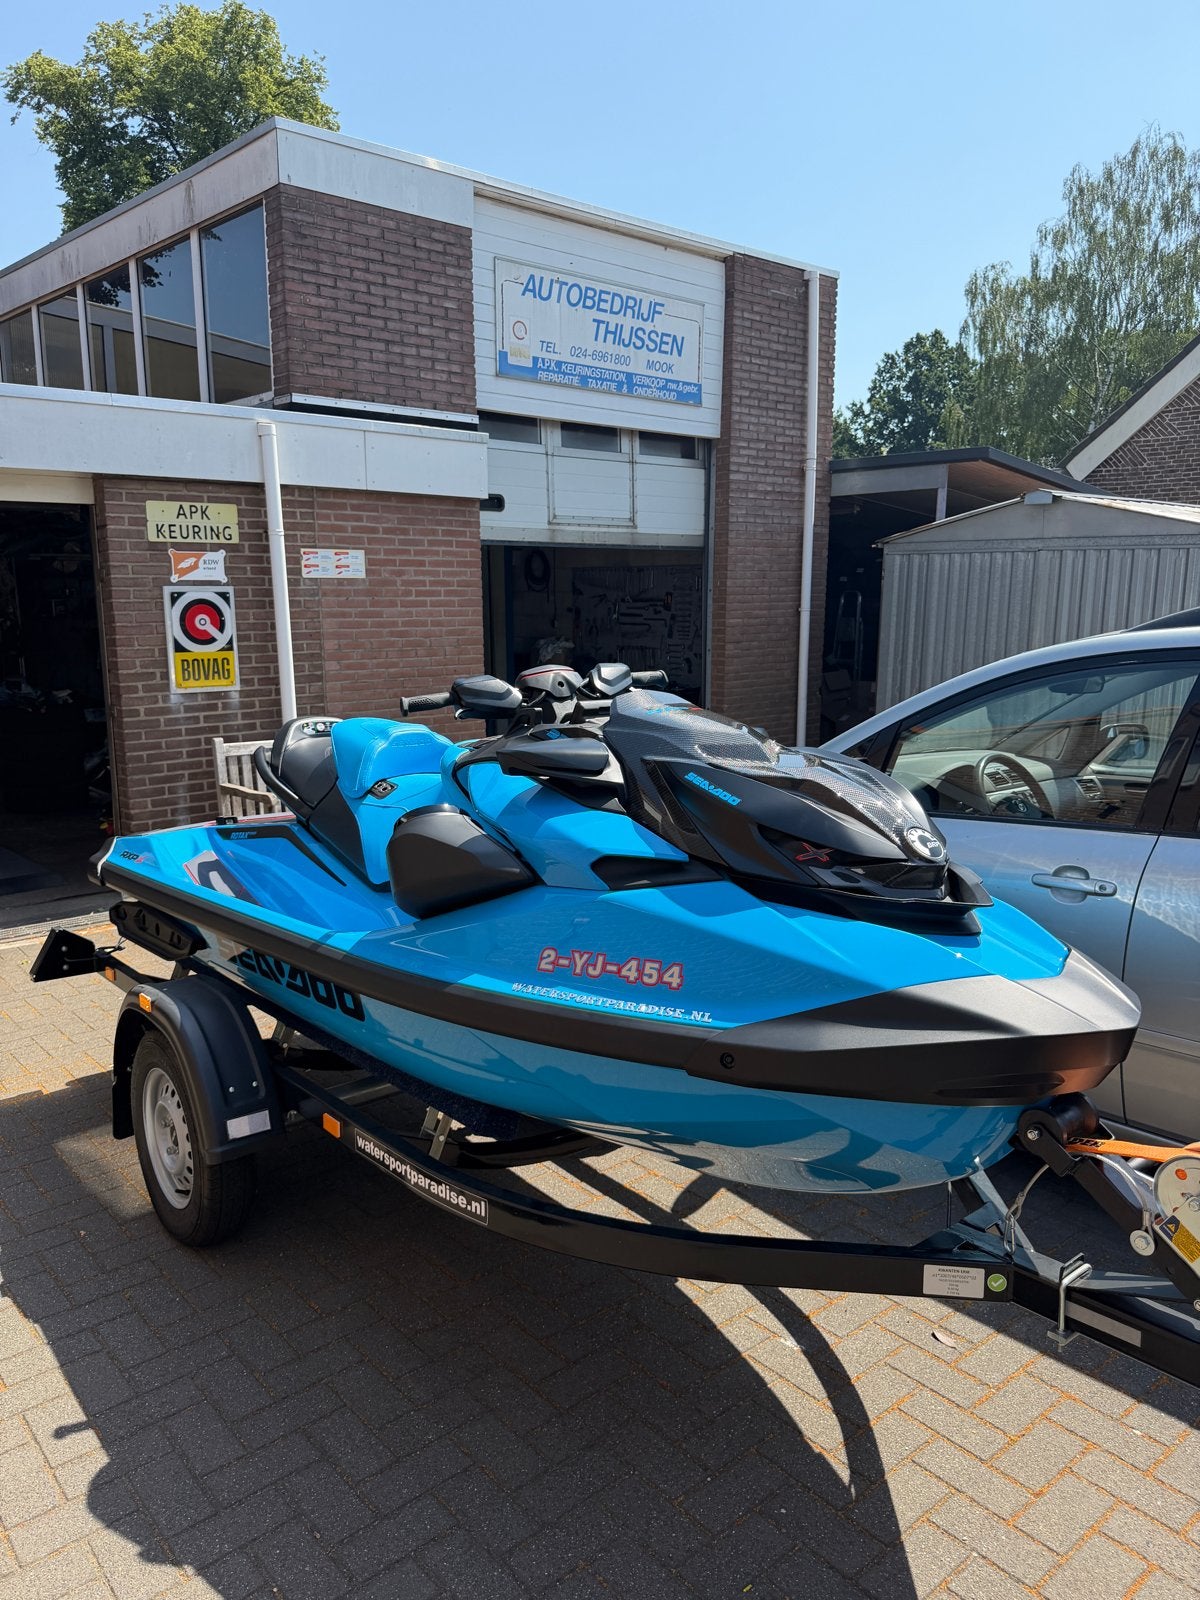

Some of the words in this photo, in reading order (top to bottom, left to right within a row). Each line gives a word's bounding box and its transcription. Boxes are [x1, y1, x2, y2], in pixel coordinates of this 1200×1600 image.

[521, 273, 665, 324] AUTOBEDRIJF
[592, 318, 685, 357] THIJSSEN
[539, 340, 561, 356] TEL.
[570, 345, 631, 367] 024-6961800
[646, 359, 674, 375] MOOK
[587, 378, 618, 392] TAXATIE
[622, 383, 628, 393] &
[633, 386, 677, 401] ONDERHOUD
[632, 374, 666, 389] VERKOOP
[176, 504, 211, 521] APK
[156, 523, 233, 541] KEURING
[181, 657, 231, 682] BOVAG
[537, 947, 684, 991] 2-YJ-454
[511, 982, 713, 1023] WATERSPORTPARADISE.NL
[356, 1135, 487, 1218] watersportparadise.nl
